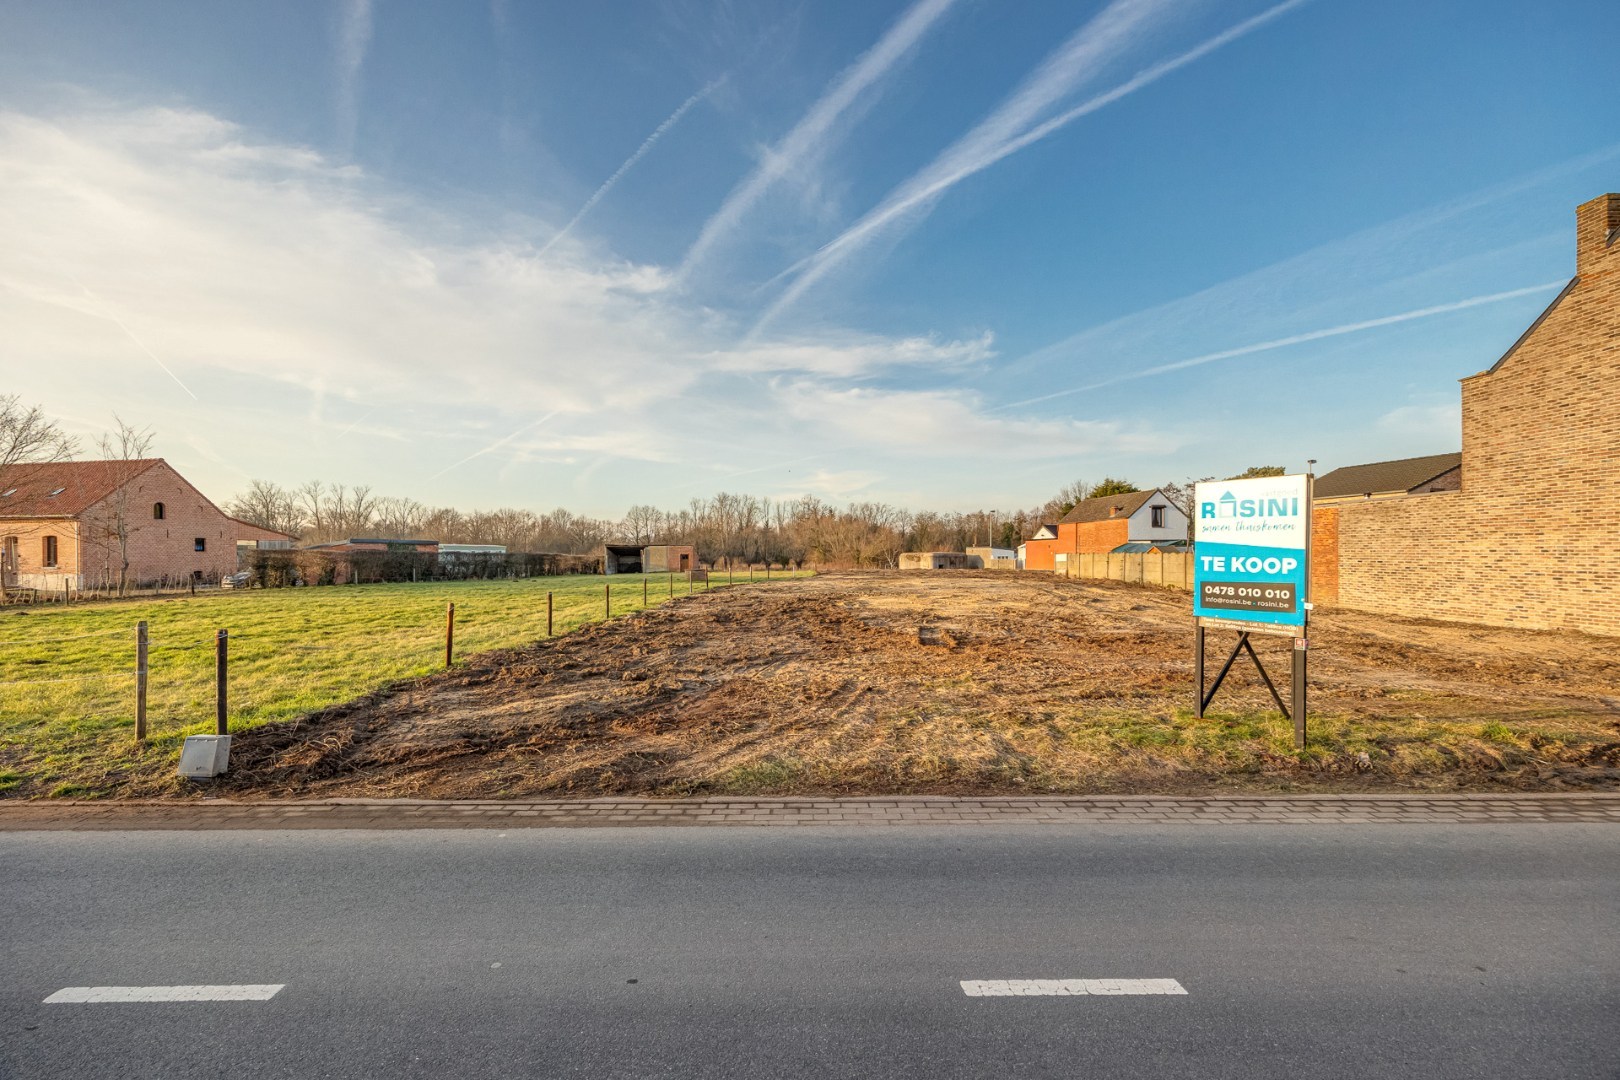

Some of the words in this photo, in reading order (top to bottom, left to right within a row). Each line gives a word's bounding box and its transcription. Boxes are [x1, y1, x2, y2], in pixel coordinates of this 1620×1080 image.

[1201, 556, 1226, 572] TE
[1231, 557, 1298, 575] KOOP
[1205, 586, 1235, 596] 0478
[1238, 588, 1261, 597] 010
[1265, 589, 1290, 599] 010
[1205, 596, 1252, 606] info@rosini.be
[1257, 601, 1290, 609] rosini.be
